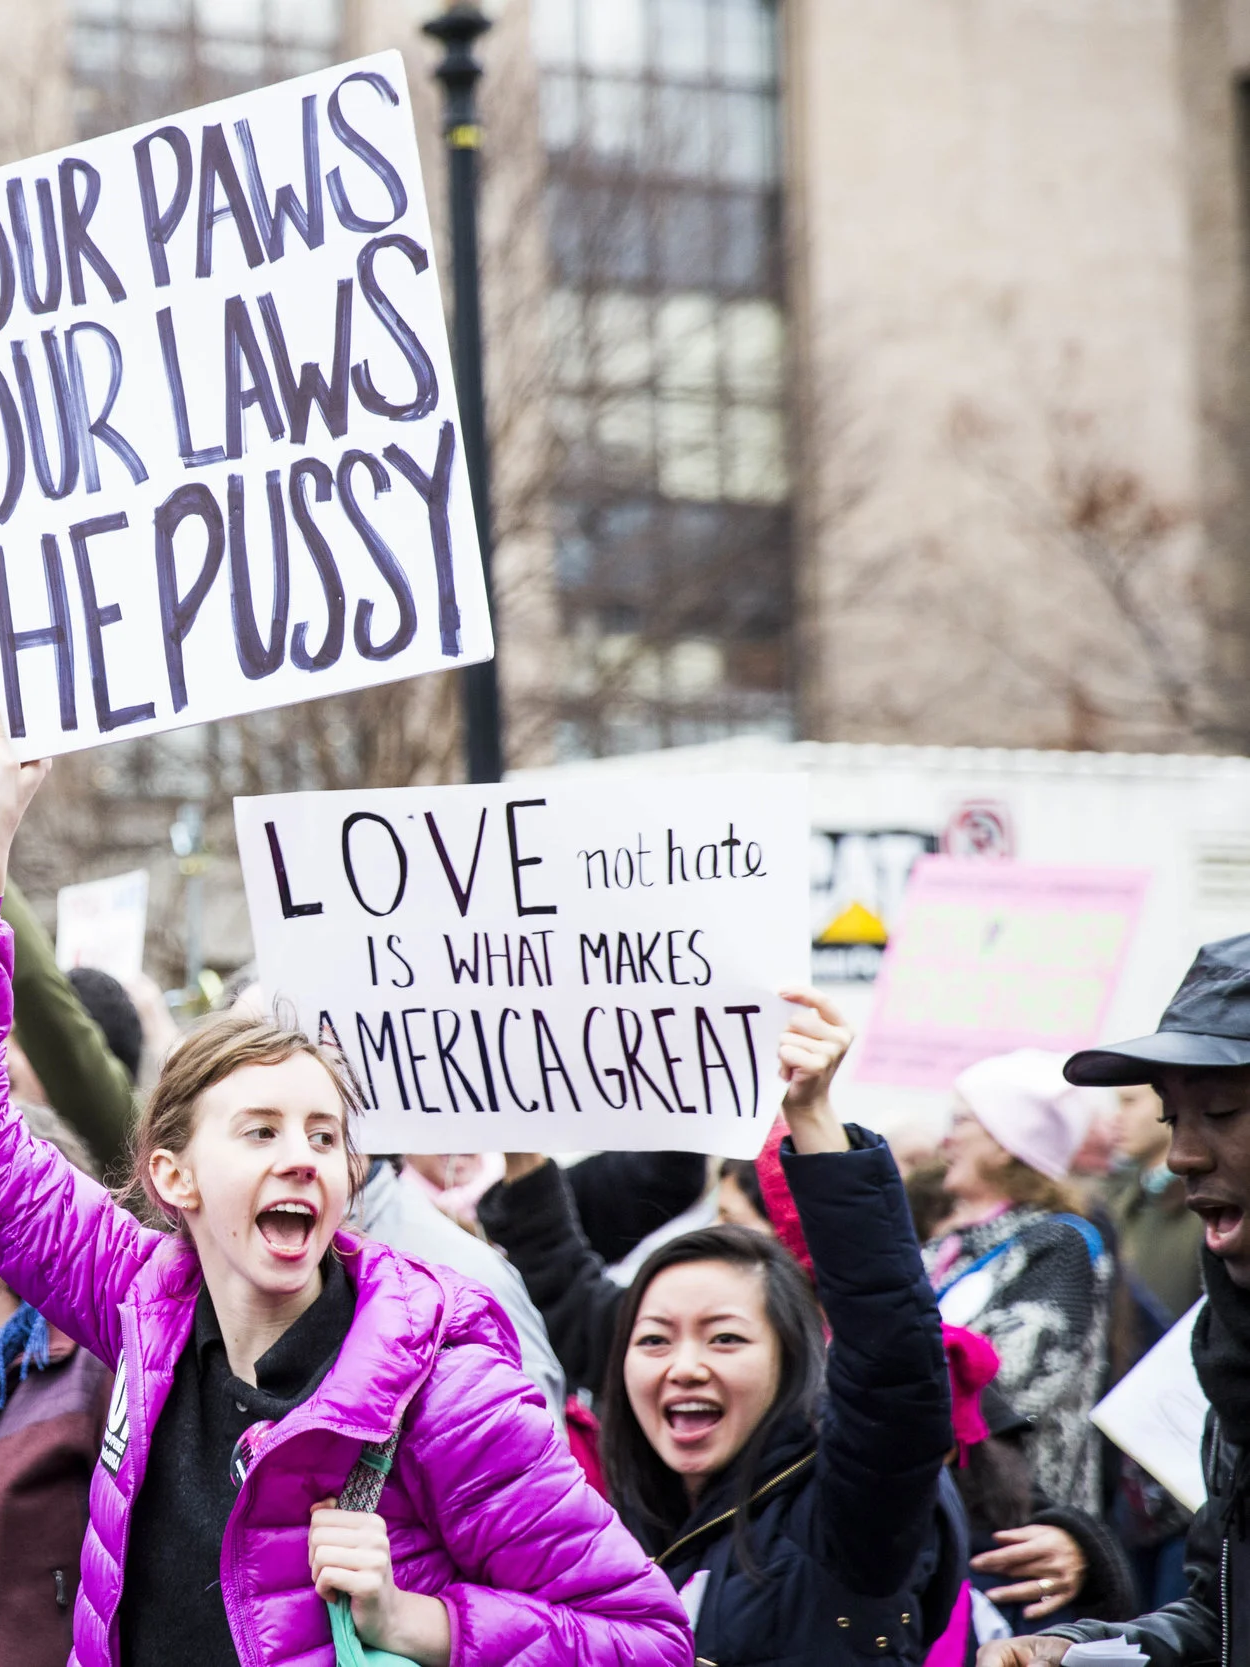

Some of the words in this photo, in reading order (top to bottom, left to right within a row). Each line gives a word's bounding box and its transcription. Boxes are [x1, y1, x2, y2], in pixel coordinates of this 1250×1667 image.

[131, 69, 410, 288] PAWS
[155, 233, 440, 469] LAWS
[153, 419, 463, 714] PUSSY
[264, 798, 558, 919] LOVE
[576, 832, 654, 889] not
[666, 822, 768, 886] hate
[367, 933, 415, 989] IS
[443, 929, 556, 988] WHAT
[579, 928, 712, 987] MAKES
[318, 1005, 583, 1114] AMERICA
[583, 1004, 762, 1118] GREAT
